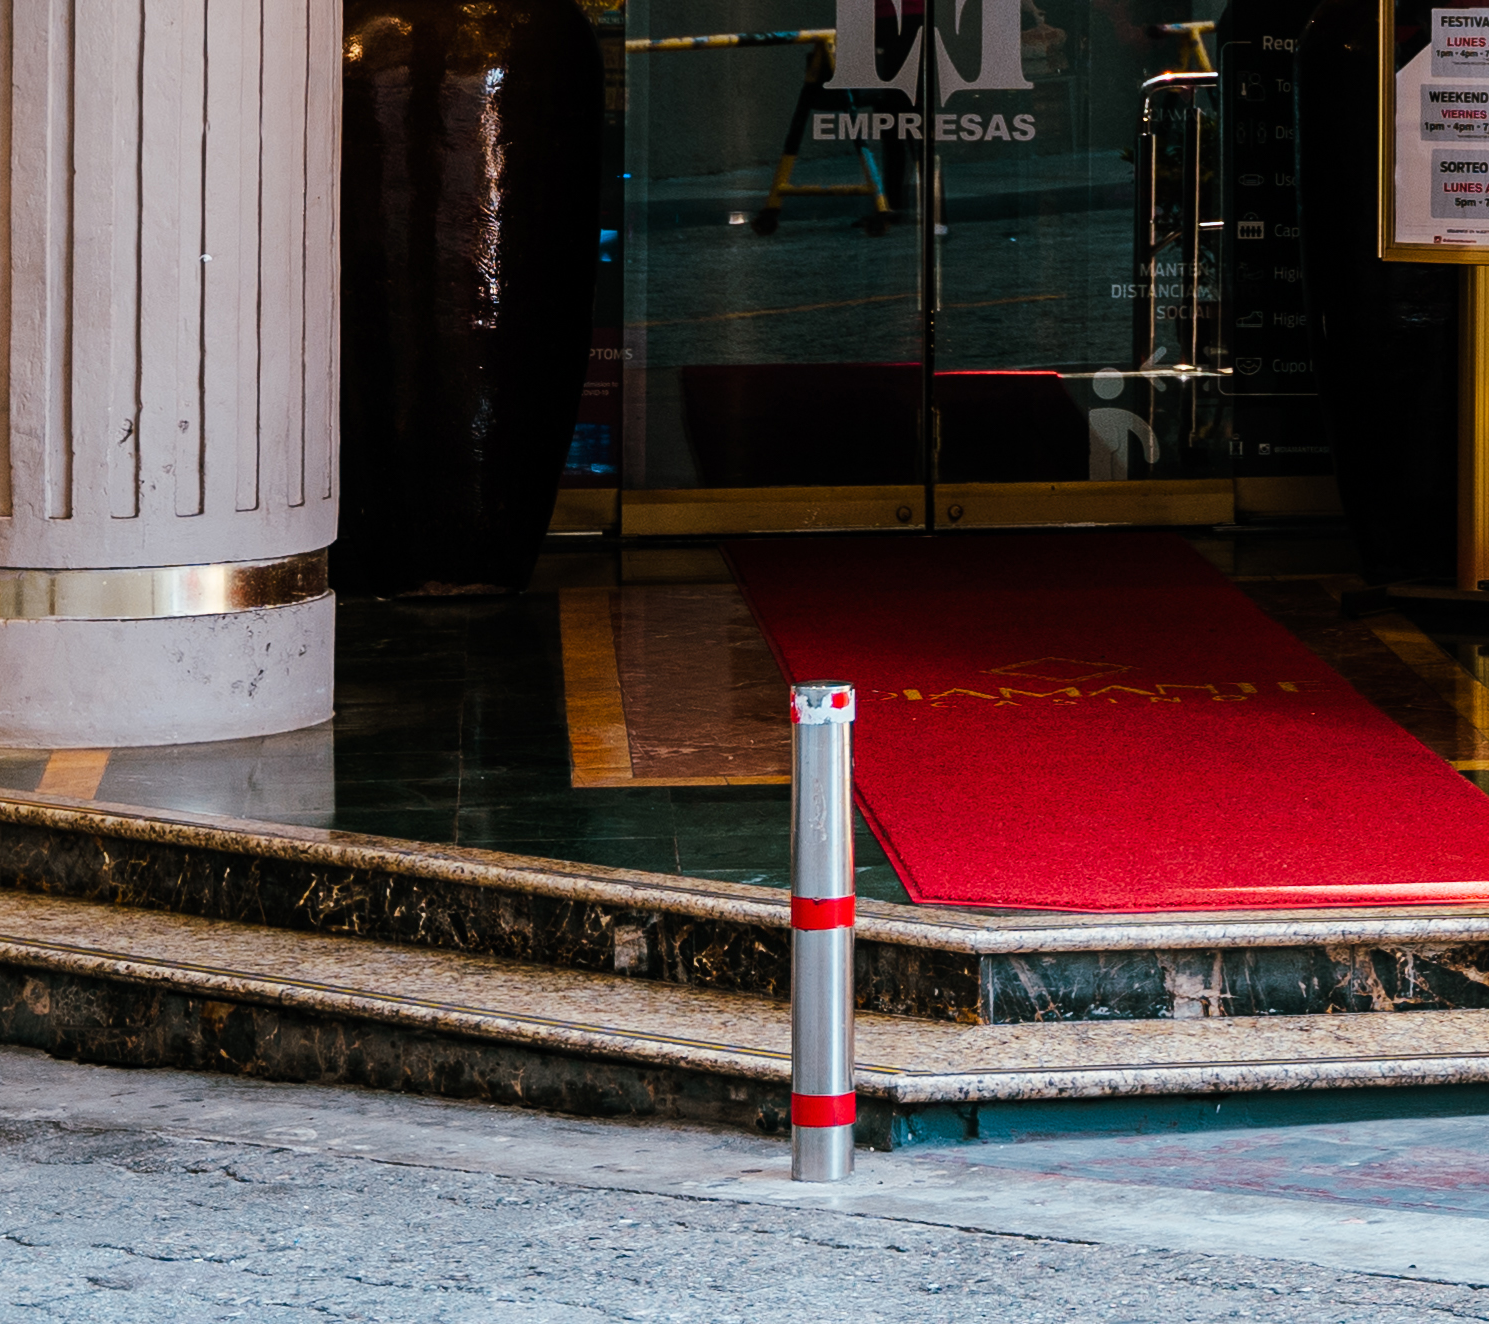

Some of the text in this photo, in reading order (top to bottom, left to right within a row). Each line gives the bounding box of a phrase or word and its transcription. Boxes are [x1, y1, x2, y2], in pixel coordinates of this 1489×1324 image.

[1446, 36, 1486, 48] LUNES
[1435, 49, 1454, 58] 1pm
[1460, 49, 1479, 58] 4pm
[1429, 90, 1489, 104] WEEKEND
[1441, 109, 1488, 120] VIERNES
[812, 112, 1037, 142] EMPRESAS
[1424, 121, 1445, 132] 1pm
[1453, 121, 1474, 132] 4pm
[1439, 160, 1489, 174] SORTEO
[1443, 182, 1483, 193] LUNES
[1454, 197, 1476, 208] 5pm
[1272, 358, 1307, 375] Cupo
